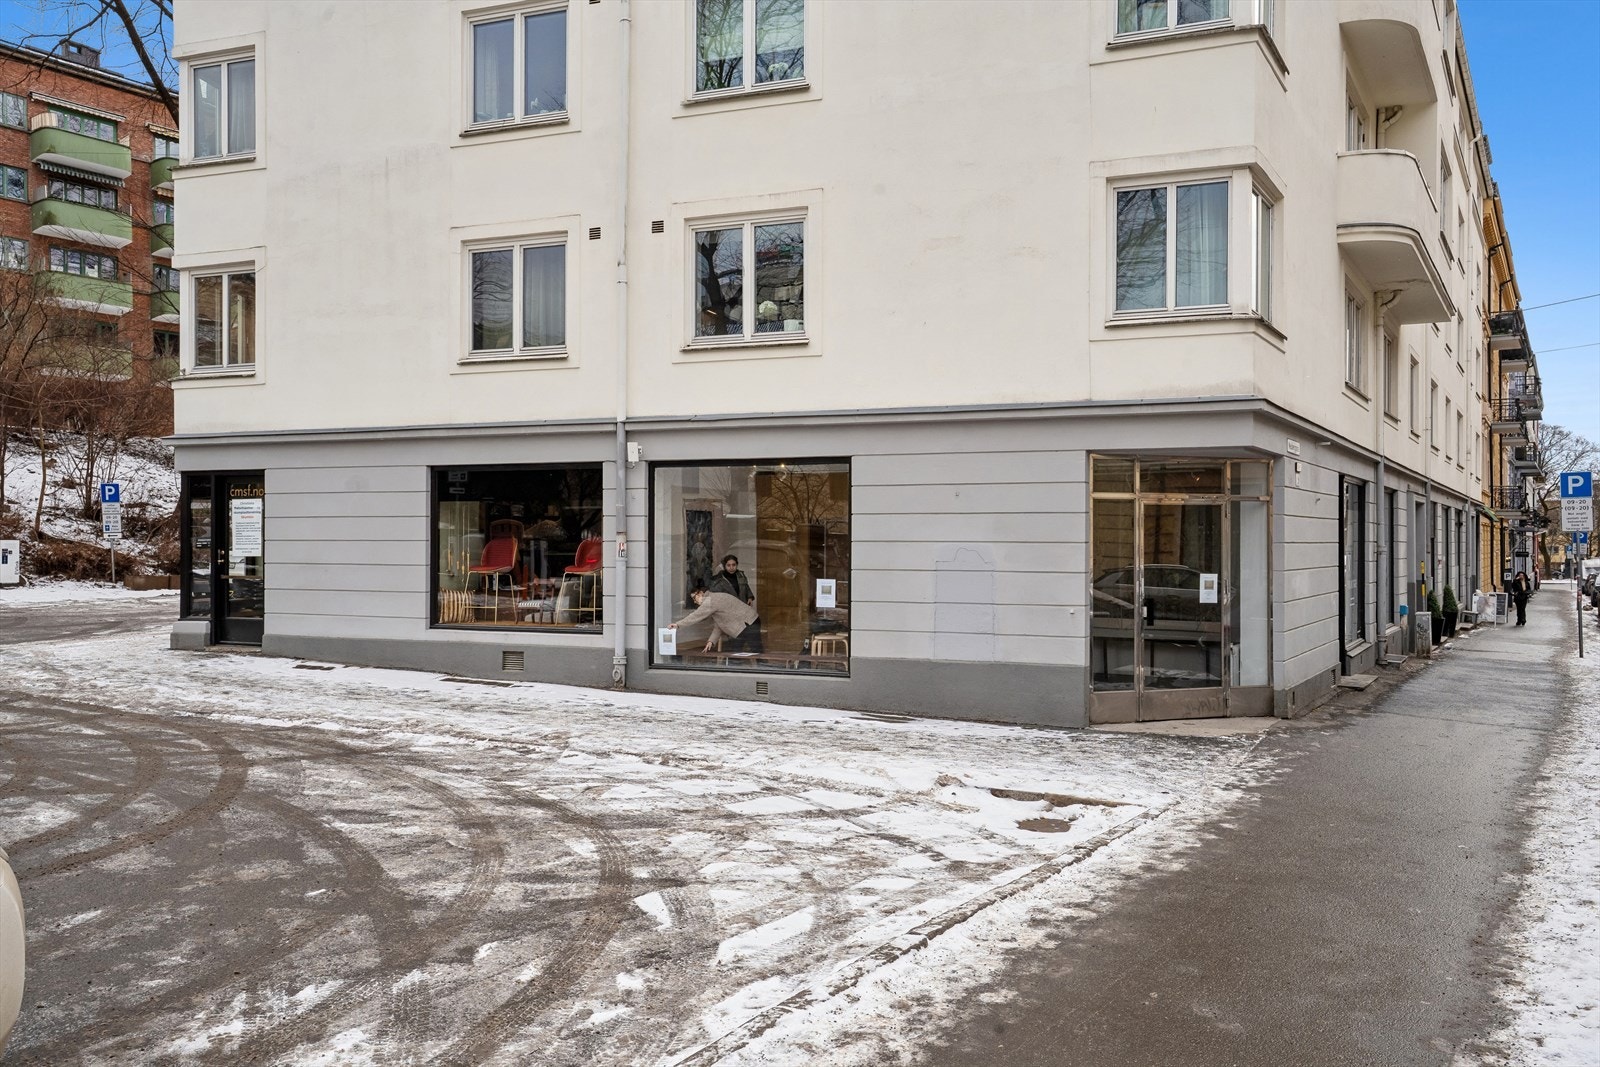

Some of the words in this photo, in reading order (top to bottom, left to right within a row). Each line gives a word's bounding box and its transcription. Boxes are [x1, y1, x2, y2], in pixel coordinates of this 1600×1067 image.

[230, 483, 264, 497] cmsf.no
[1567, 475, 1585, 495] P
[105, 486, 115, 500] P
